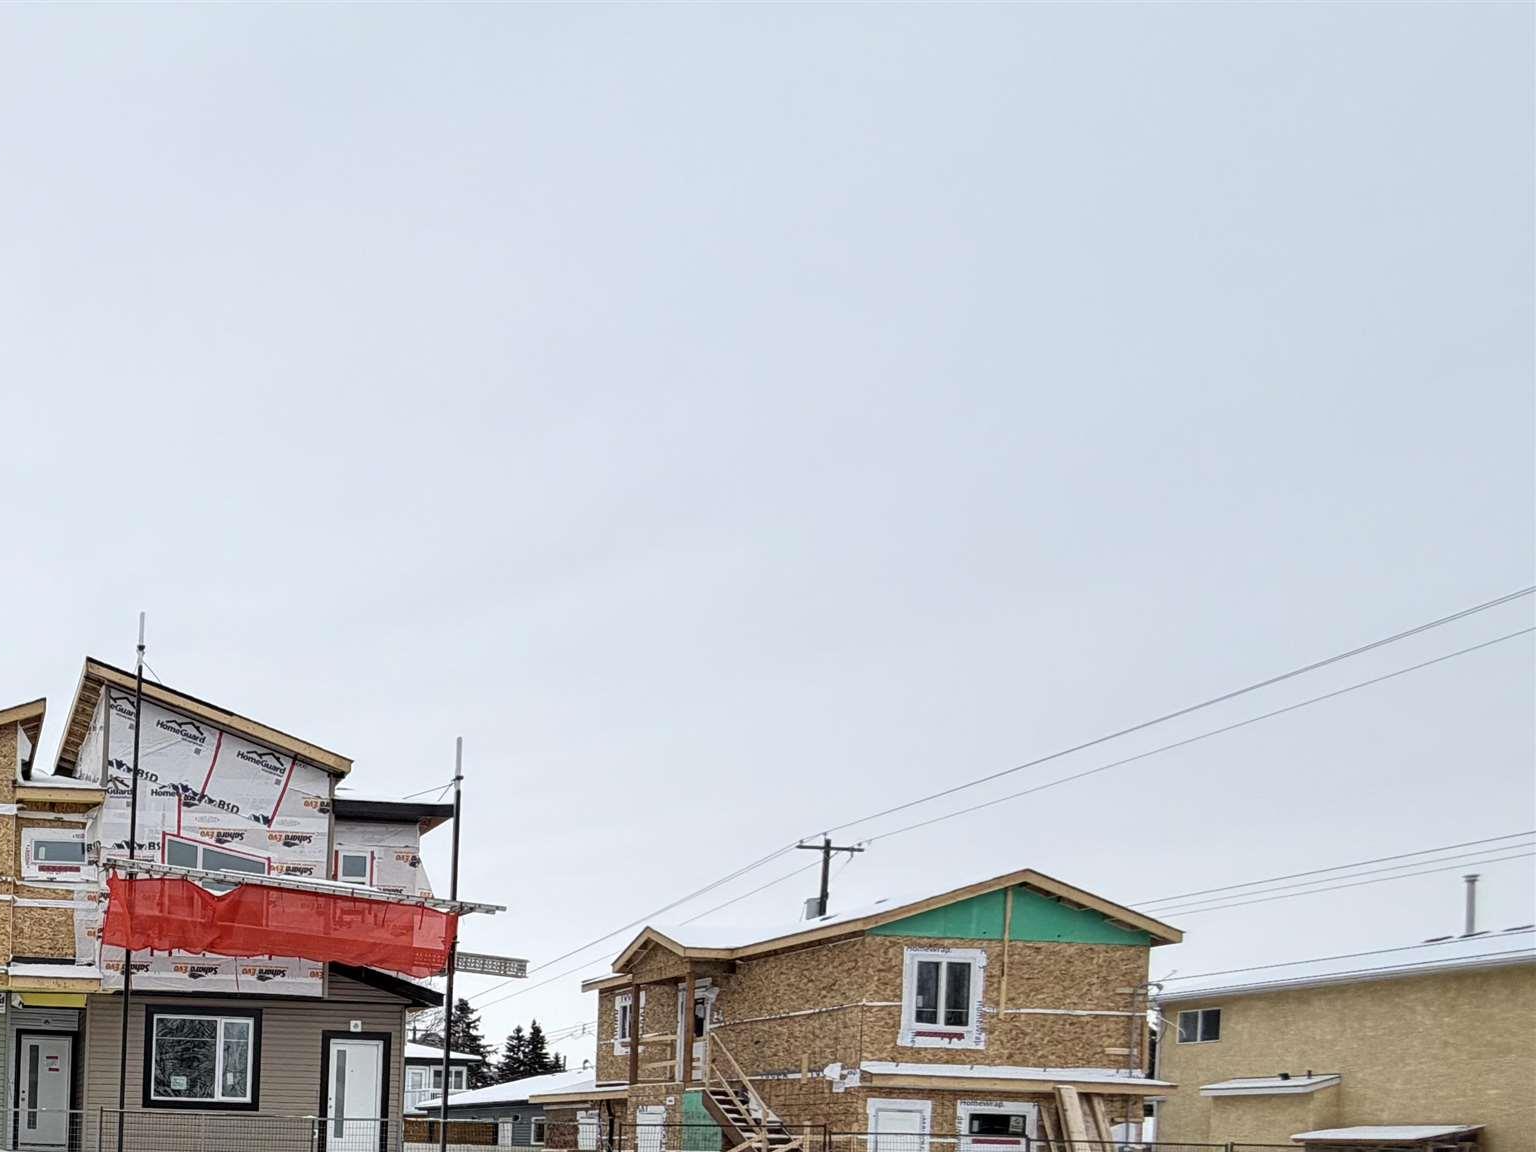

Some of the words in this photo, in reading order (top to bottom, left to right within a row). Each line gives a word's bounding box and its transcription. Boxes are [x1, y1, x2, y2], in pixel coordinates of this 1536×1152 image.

[156, 719, 206, 744] HomeGuard
[236, 750, 287, 775] HomeGuard
[217, 799, 240, 815] BSD
